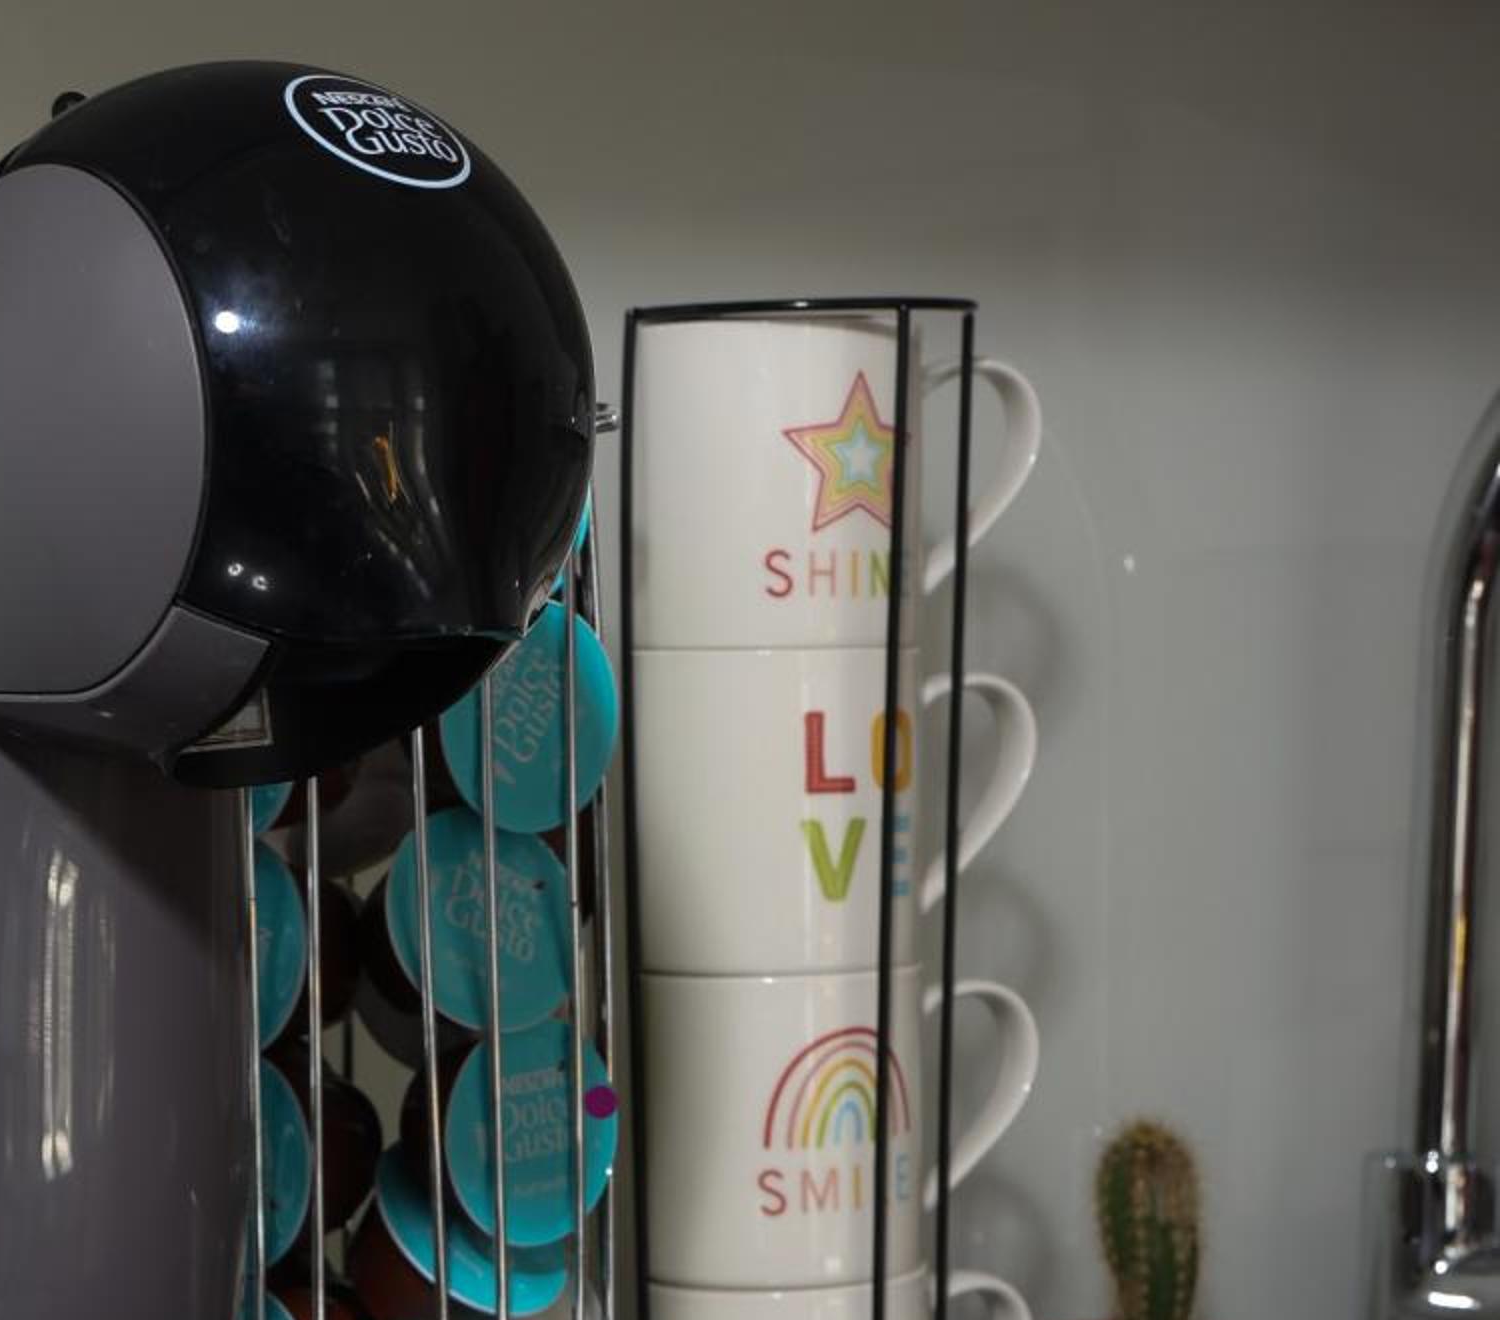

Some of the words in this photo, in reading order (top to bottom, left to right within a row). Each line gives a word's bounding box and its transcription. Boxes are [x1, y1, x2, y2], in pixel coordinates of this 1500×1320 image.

[318, 107, 442, 139] Dolce
[345, 130, 459, 163] Gusto
[764, 549, 909, 599] SHIN
[757, 1152, 910, 1217] SMIE
